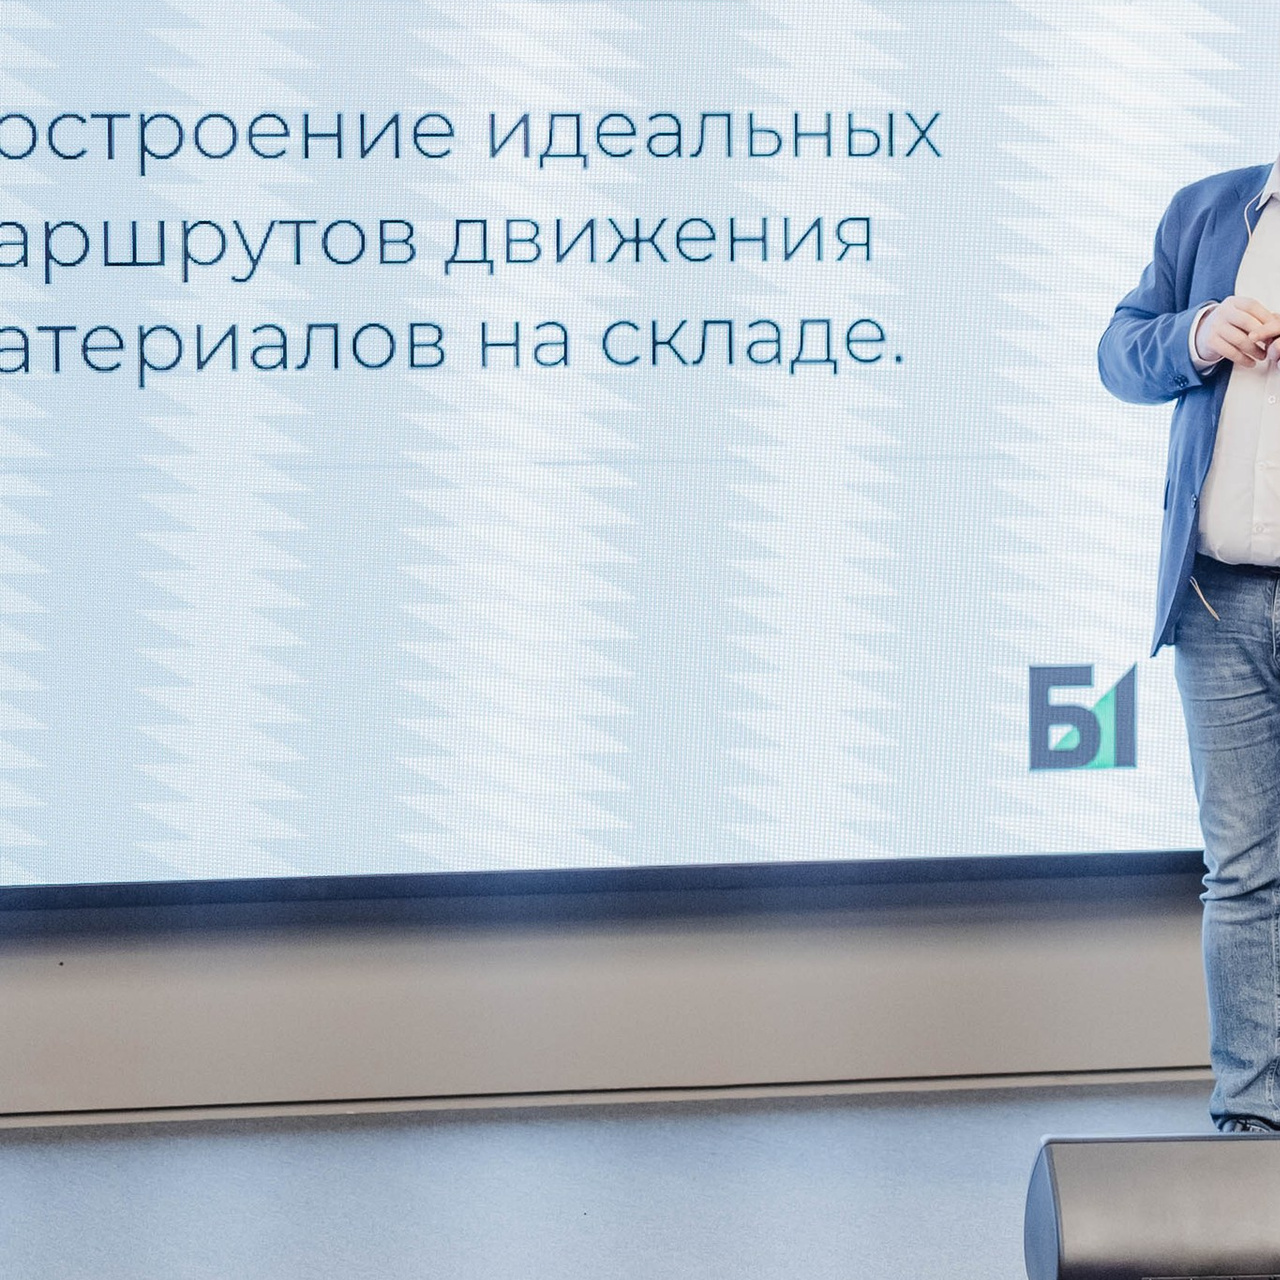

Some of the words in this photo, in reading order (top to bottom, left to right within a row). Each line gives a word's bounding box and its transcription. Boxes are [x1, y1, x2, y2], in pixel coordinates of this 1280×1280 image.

[0, 111, 456, 177] остроение
[488, 110, 943, 170] идеальных
[0, 219, 417, 285] аршрутов
[443, 215, 873, 276] движения
[0, 321, 447, 389] атериалов
[480, 319, 570, 369] на
[600, 317, 905, 376] складе.
